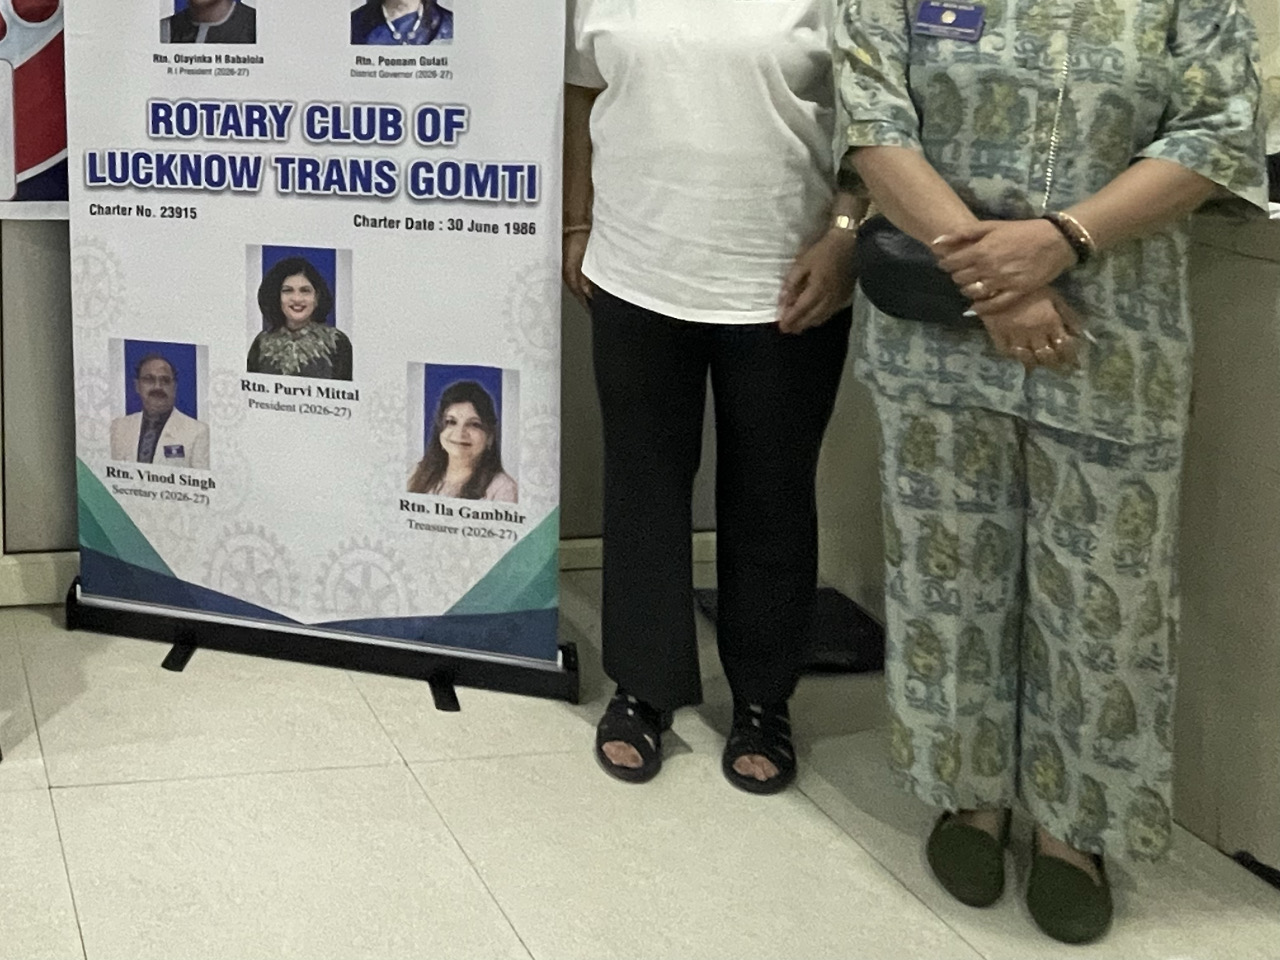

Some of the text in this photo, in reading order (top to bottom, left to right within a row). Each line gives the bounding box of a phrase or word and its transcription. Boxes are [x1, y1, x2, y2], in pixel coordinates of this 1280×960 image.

[215, 54, 222, 63] H
[378, 55, 417, 66] Poonam
[419, 55, 448, 66] Gulati
[150, 101, 468, 144] ROTARY CLUB OF
[86, 151, 540, 202] LUCKNOW TRANS GOMTI
[89, 203, 198, 220] Charter No. 23915
[353, 214, 401, 230] Charter
[405, 216, 436, 232] Date
[447, 217, 464, 233] 30
[467, 218, 500, 235] June
[504, 221, 537, 236] 1986
[240, 378, 360, 402] Rtn. Purvi Mittal
[247, 398, 352, 419] President (2026-27)
[105, 465, 216, 492] Rtn. Vinod Singh
[111, 484, 159, 502] Secretary
[399, 498, 526, 524] Rtn. Ila Gambhir
[407, 518, 518, 542] Treasurer (2026-27)
